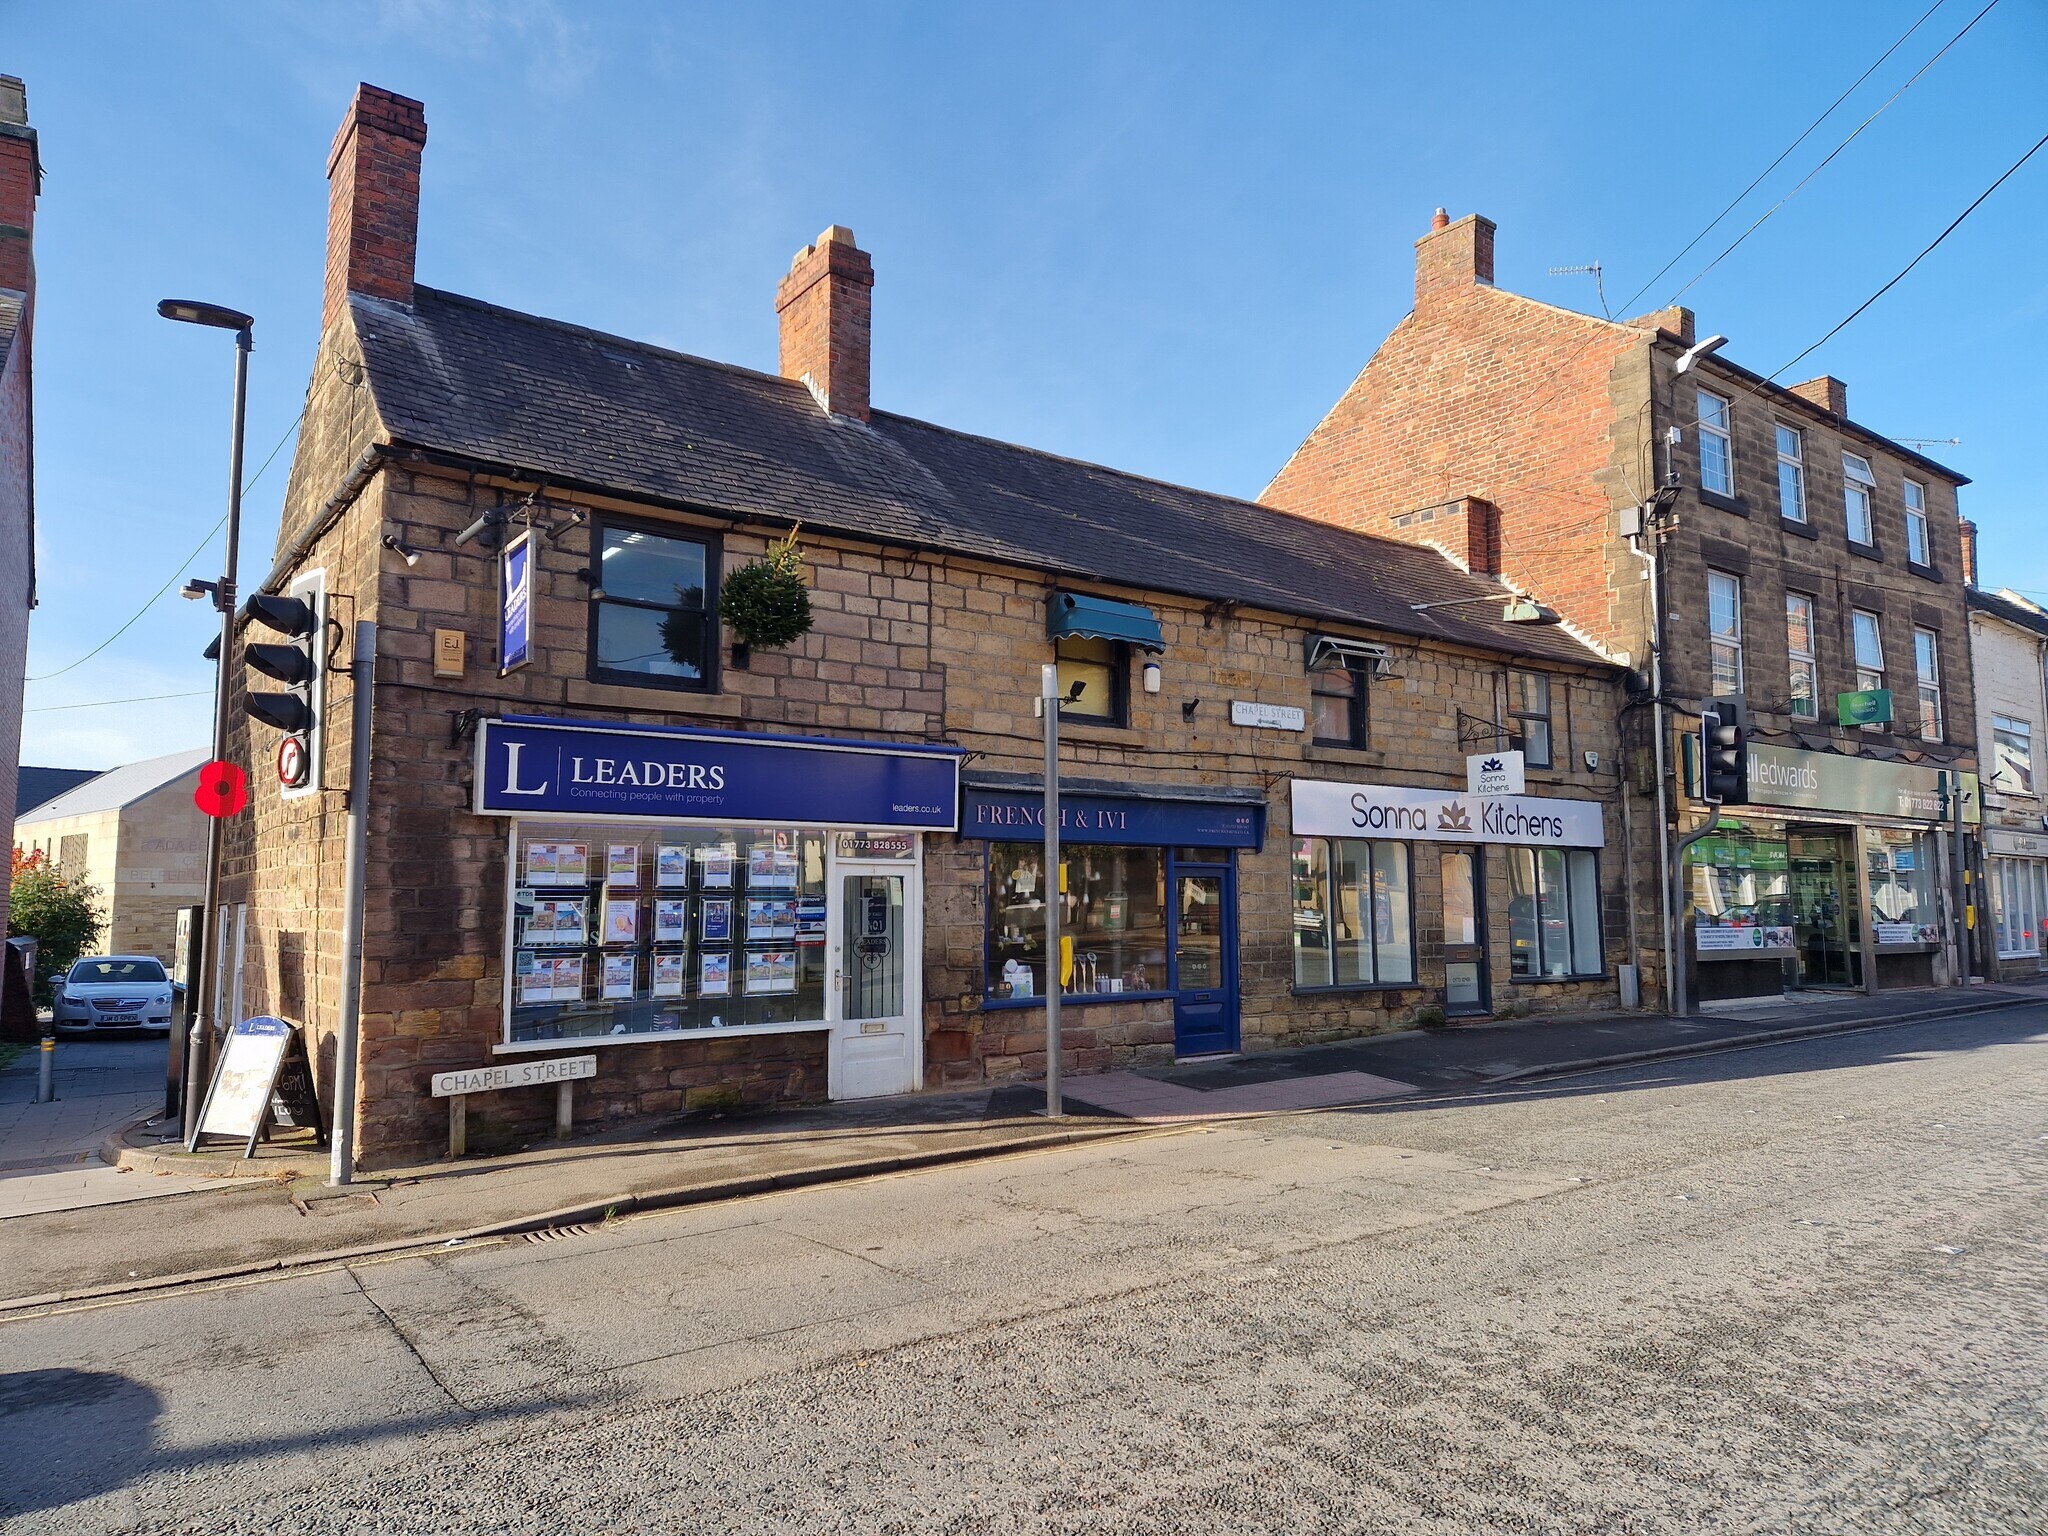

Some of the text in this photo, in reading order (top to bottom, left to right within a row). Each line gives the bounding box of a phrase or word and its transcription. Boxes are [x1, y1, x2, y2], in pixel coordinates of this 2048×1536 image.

[1236, 704, 1301, 720] CHAPEL STREET
[500, 742, 548, 796] L
[571, 757, 725, 791] LEADERS
[1480, 773, 1506, 784] Sonna
[570, 786, 725, 806] Connecting people with property
[1477, 784, 1510, 794] Kitchens
[892, 803, 942, 814] leaders.co.uk
[1904, 797, 1921, 809] 01773
[1922, 799, 1933, 810] 822
[1933, 800, 1945, 811] 622
[1075, 809, 1089, 828] &
[1097, 811, 1126, 829] IVI
[1351, 792, 1563, 838] Sonna Kitchens
[843, 839, 907, 851] 01773 828555
[440, 1059, 590, 1092] CHAPEL STREET
